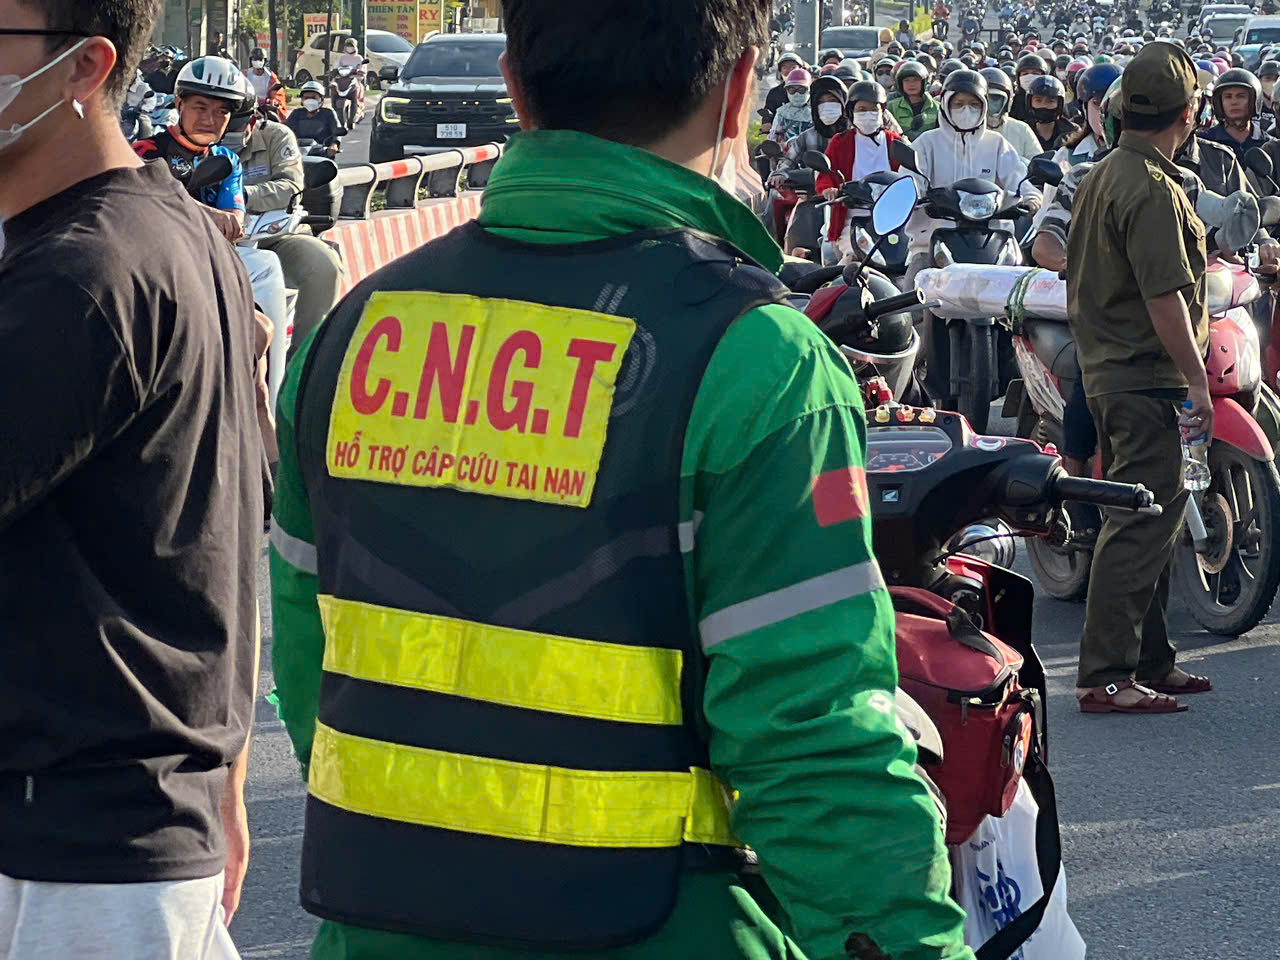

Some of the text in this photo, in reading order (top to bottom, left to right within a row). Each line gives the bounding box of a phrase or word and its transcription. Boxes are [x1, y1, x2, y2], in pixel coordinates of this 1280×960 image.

[307, 24, 329, 37] BID
[350, 316, 617, 439] C.N.G.T
[335, 431, 362, 468] HỖ
[368, 444, 409, 478] TRỢ
[457, 451, 498, 486] CỨU
[506, 461, 539, 491] TAI
[544, 466, 586, 500] NẠN
